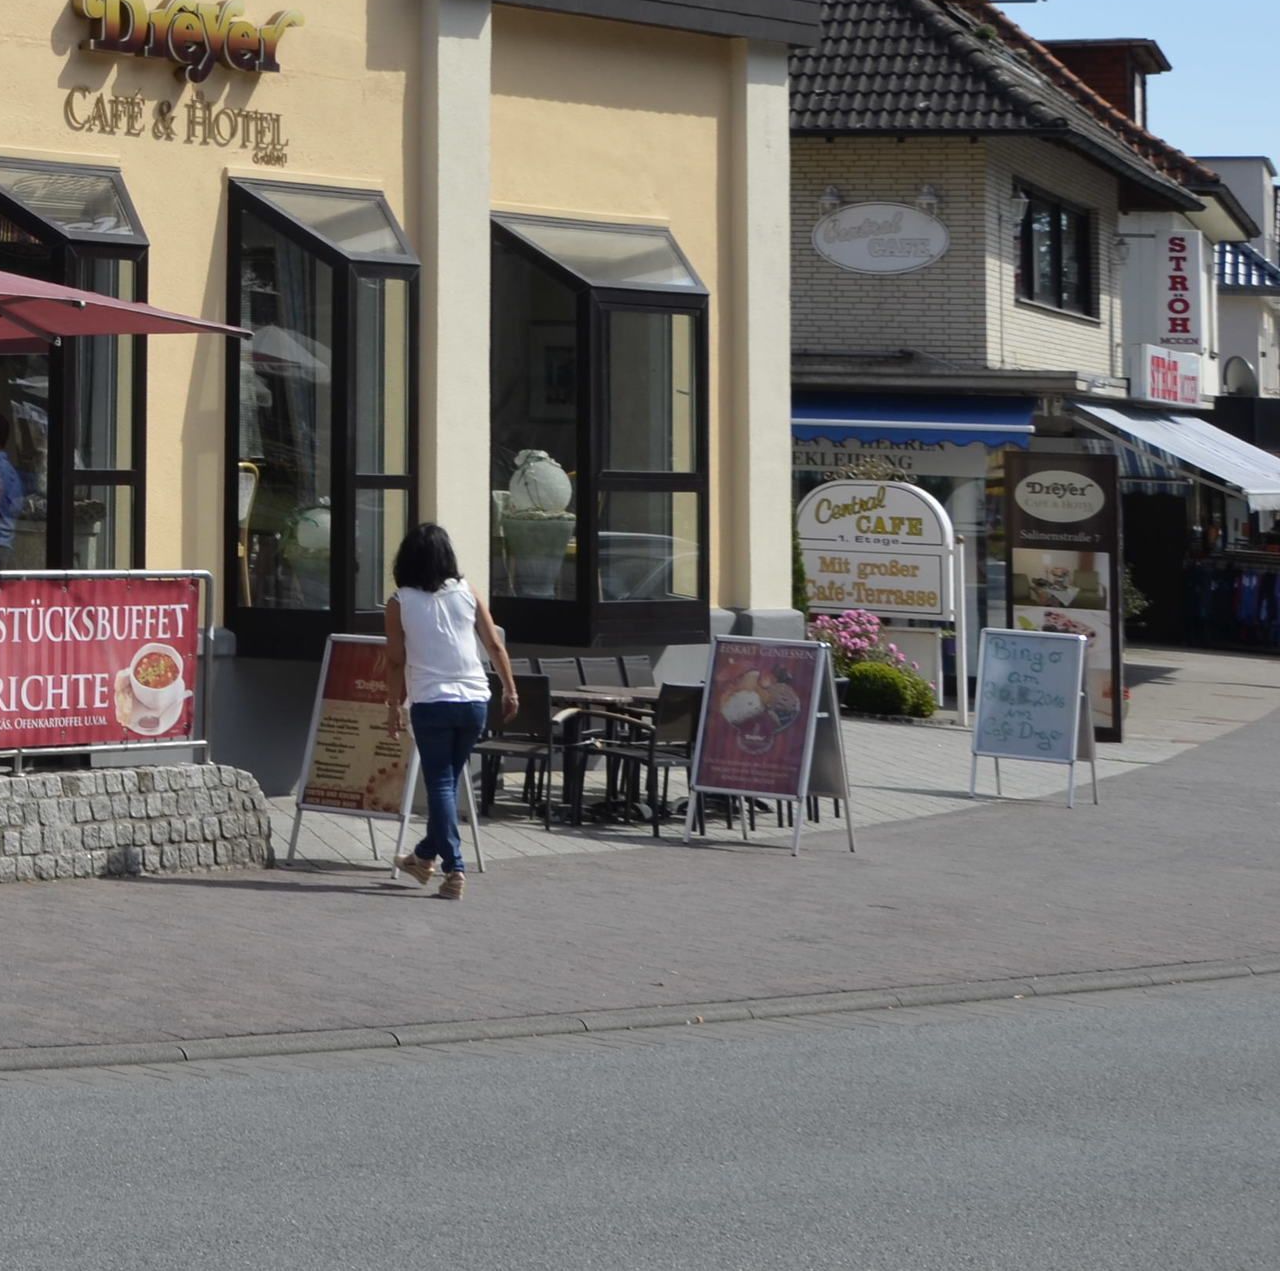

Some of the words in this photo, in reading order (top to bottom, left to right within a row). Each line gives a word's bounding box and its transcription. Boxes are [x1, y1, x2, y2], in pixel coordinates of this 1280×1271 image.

[64, 87, 145, 137] CAFÉ
[152, 100, 177, 142] &
[184, 96, 289, 151] HOTEL
[1167, 237, 1191, 334] STRÖH
[1159, 337, 1200, 346] MODEN
[1026, 481, 1095, 499] Dreyer
[815, 486, 886, 524] Central
[856, 515, 924, 537] CAFE
[838, 535, 849, 544] 1.
[855, 535, 901, 547] Etage
[818, 556, 851, 574] Mit
[857, 559, 920, 580] großer
[805, 579, 938, 608] Café-Terrasse
[989, 636, 1064, 673] Bingo
[14, 715, 83, 730] OFENKARTOFFEL
